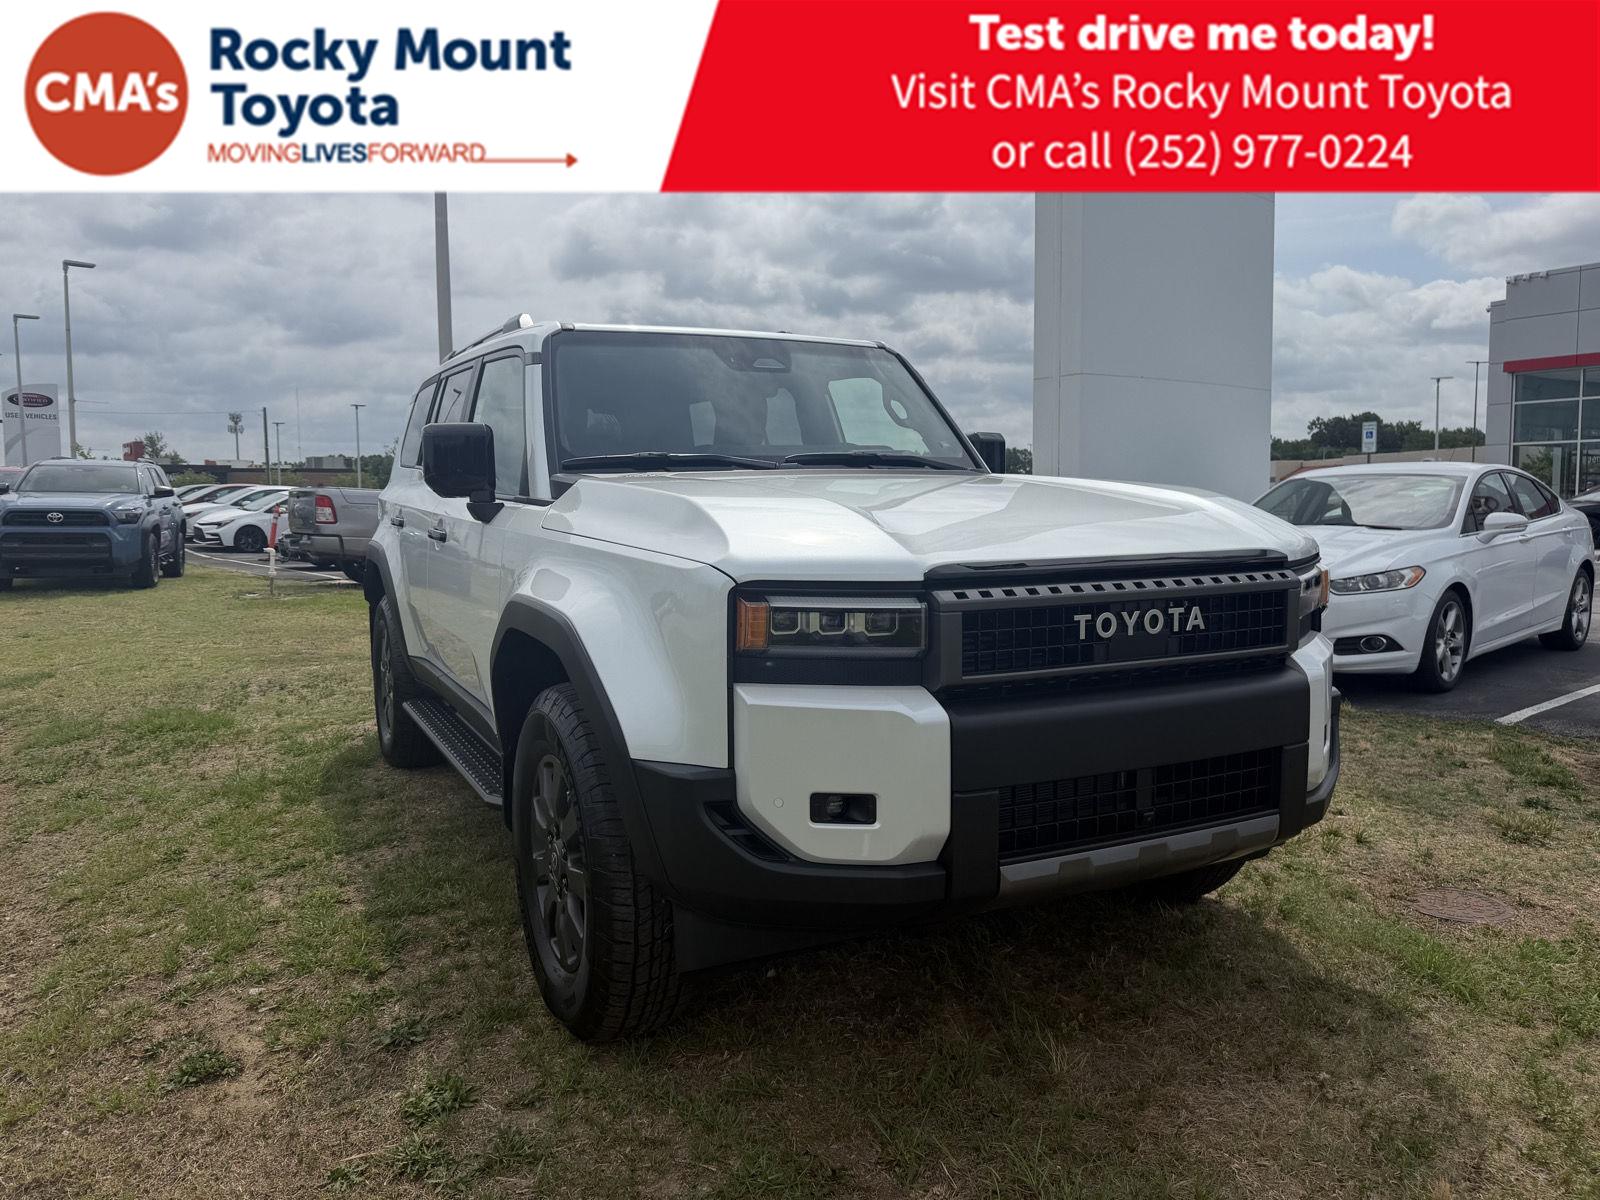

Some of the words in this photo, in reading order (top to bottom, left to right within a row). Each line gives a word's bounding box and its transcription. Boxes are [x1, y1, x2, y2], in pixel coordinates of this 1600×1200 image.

[4, 411, 22, 419] USE
[25, 412, 57, 420] VEHICLES
[1073, 606, 1206, 640] TOYOTA
